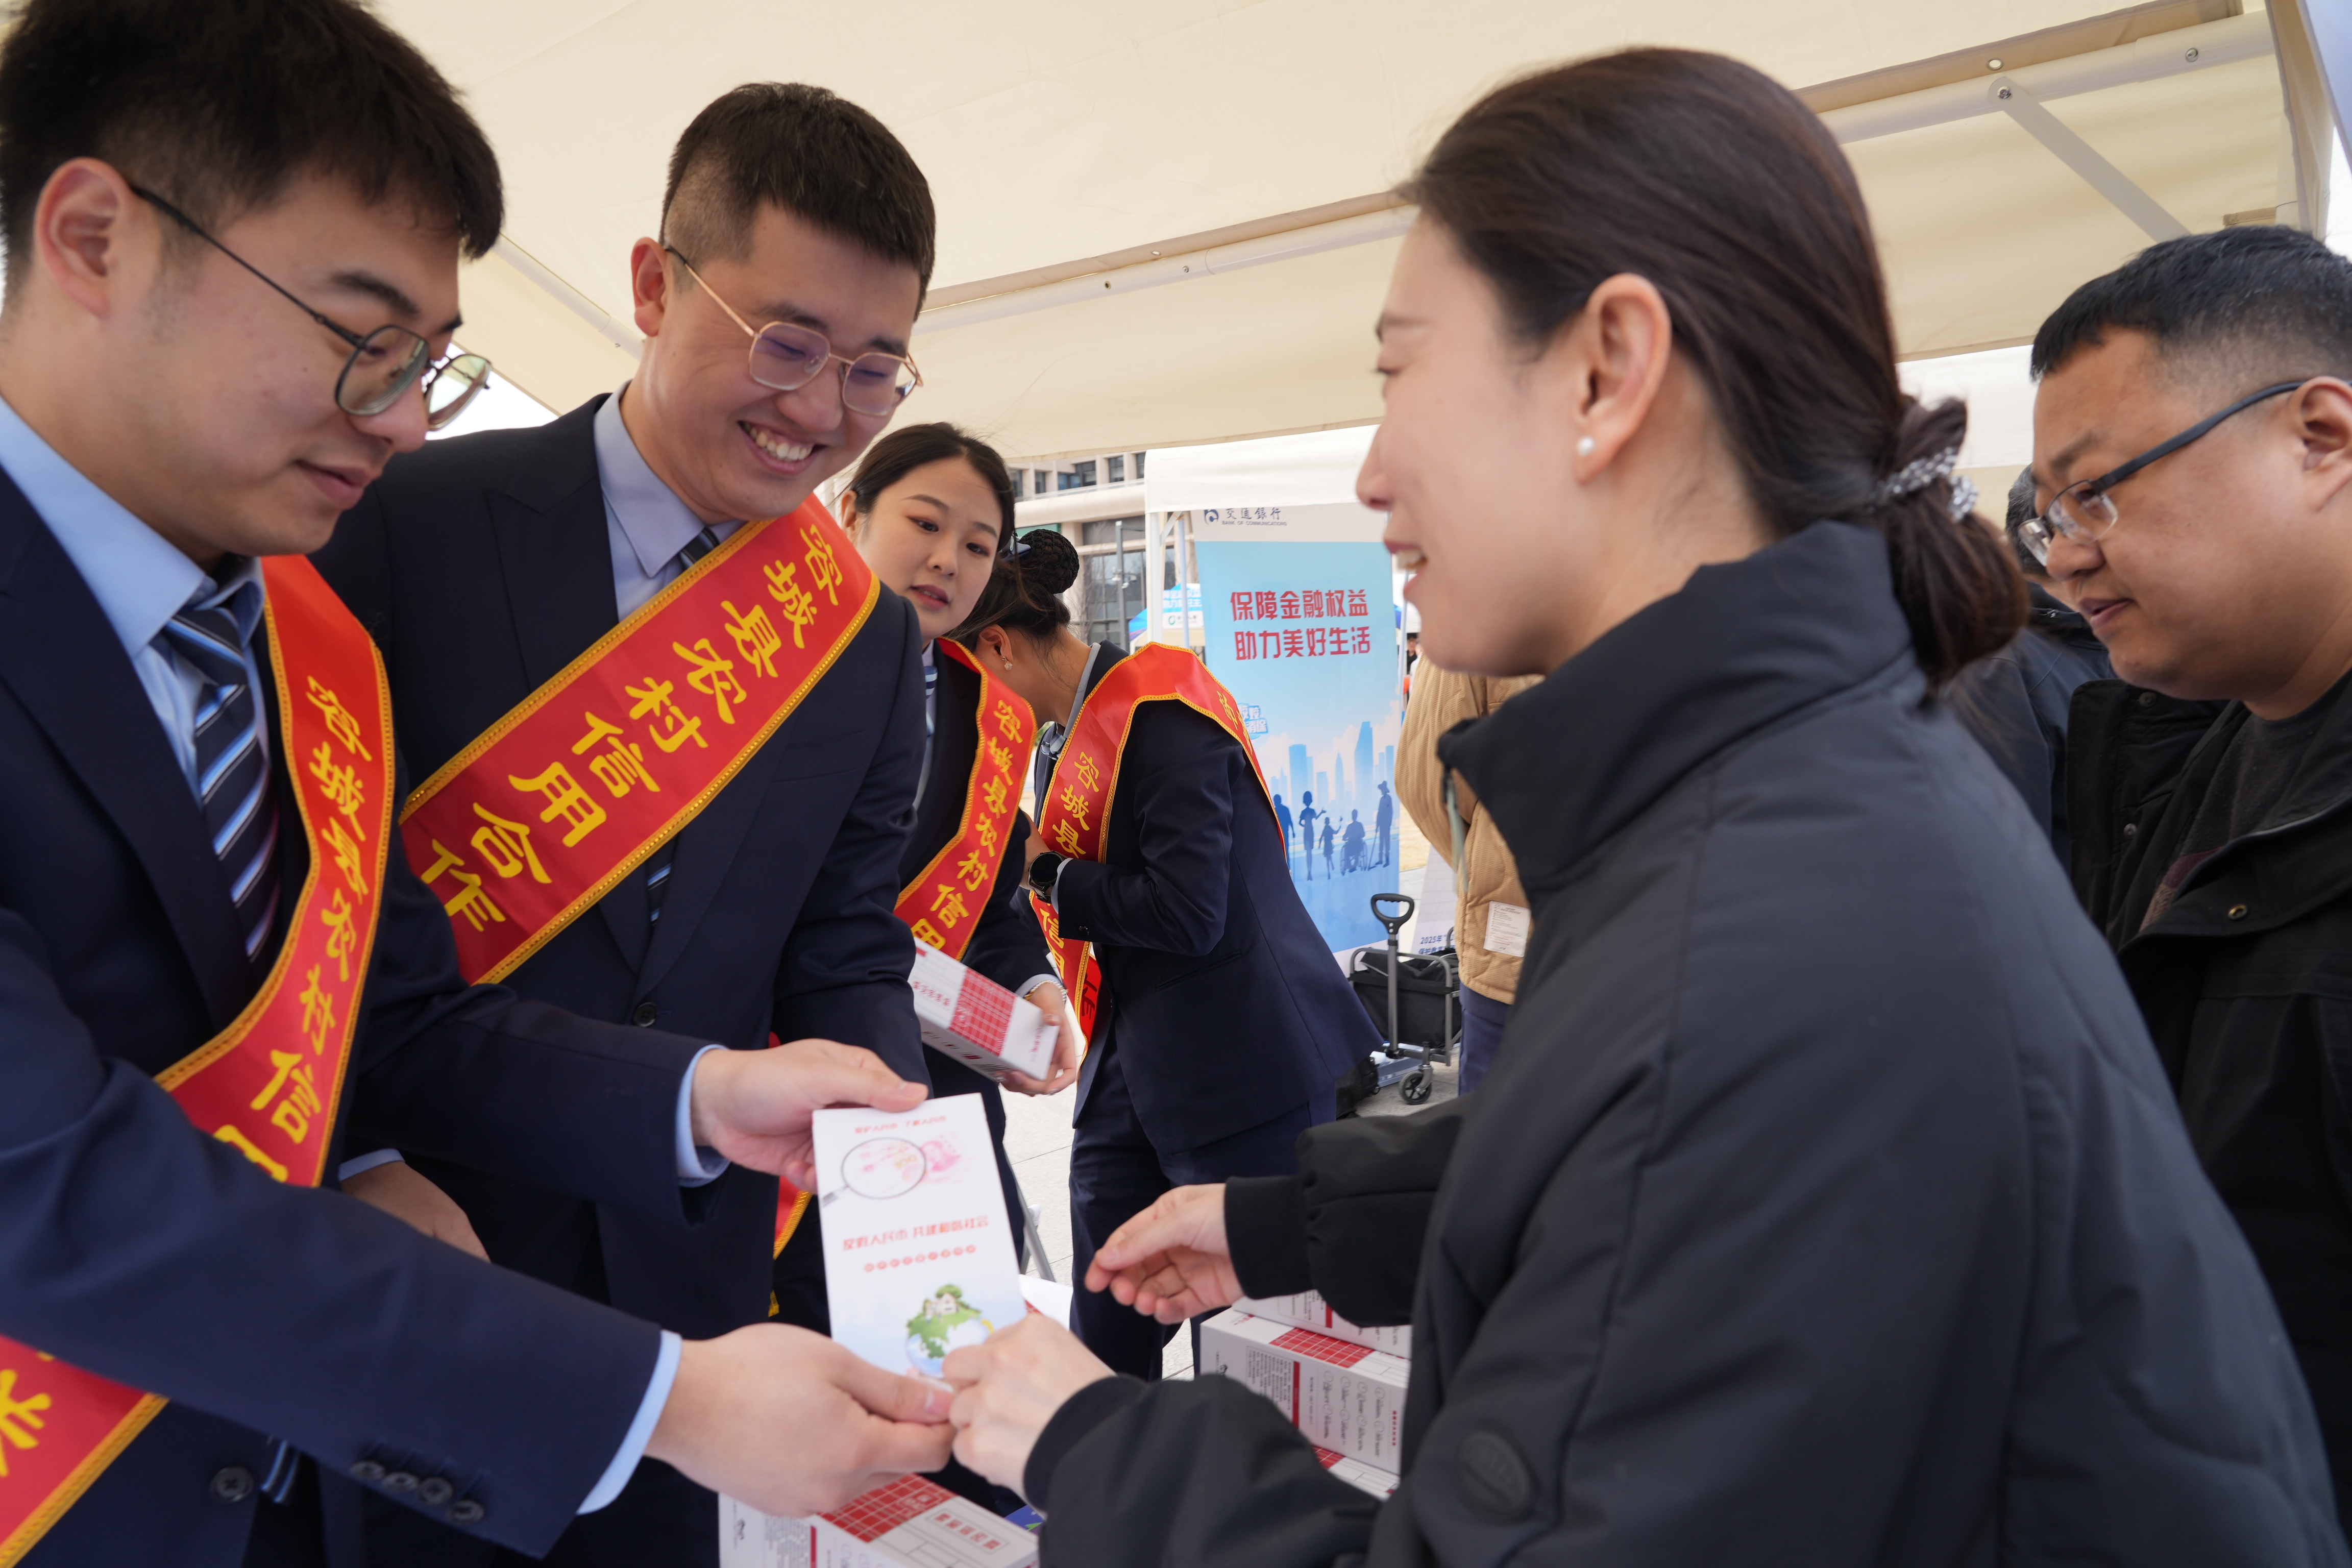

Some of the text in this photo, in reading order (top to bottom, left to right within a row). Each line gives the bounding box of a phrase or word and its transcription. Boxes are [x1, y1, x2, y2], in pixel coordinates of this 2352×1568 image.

[1230, 589, 1369, 622] 保障金融权益
[1234, 626, 1371, 660] 助力美好生活
